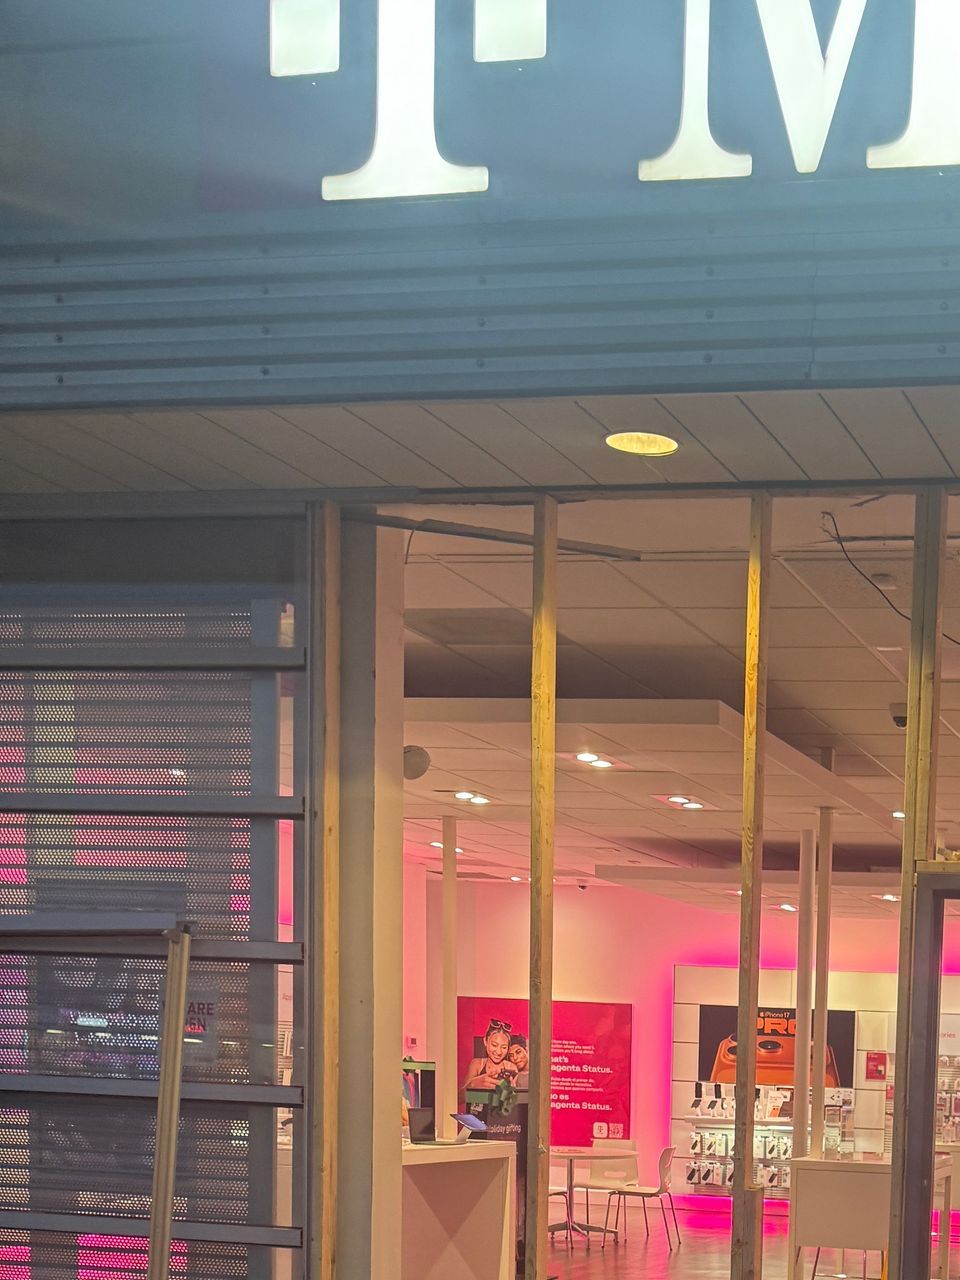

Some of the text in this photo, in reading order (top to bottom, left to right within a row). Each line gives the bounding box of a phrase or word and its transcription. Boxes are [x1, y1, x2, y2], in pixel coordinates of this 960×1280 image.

[187, 1002, 215, 1015] ARE
[582, 1065, 613, 1073] Status.
[551, 1102, 613, 1111] agenta Status.
